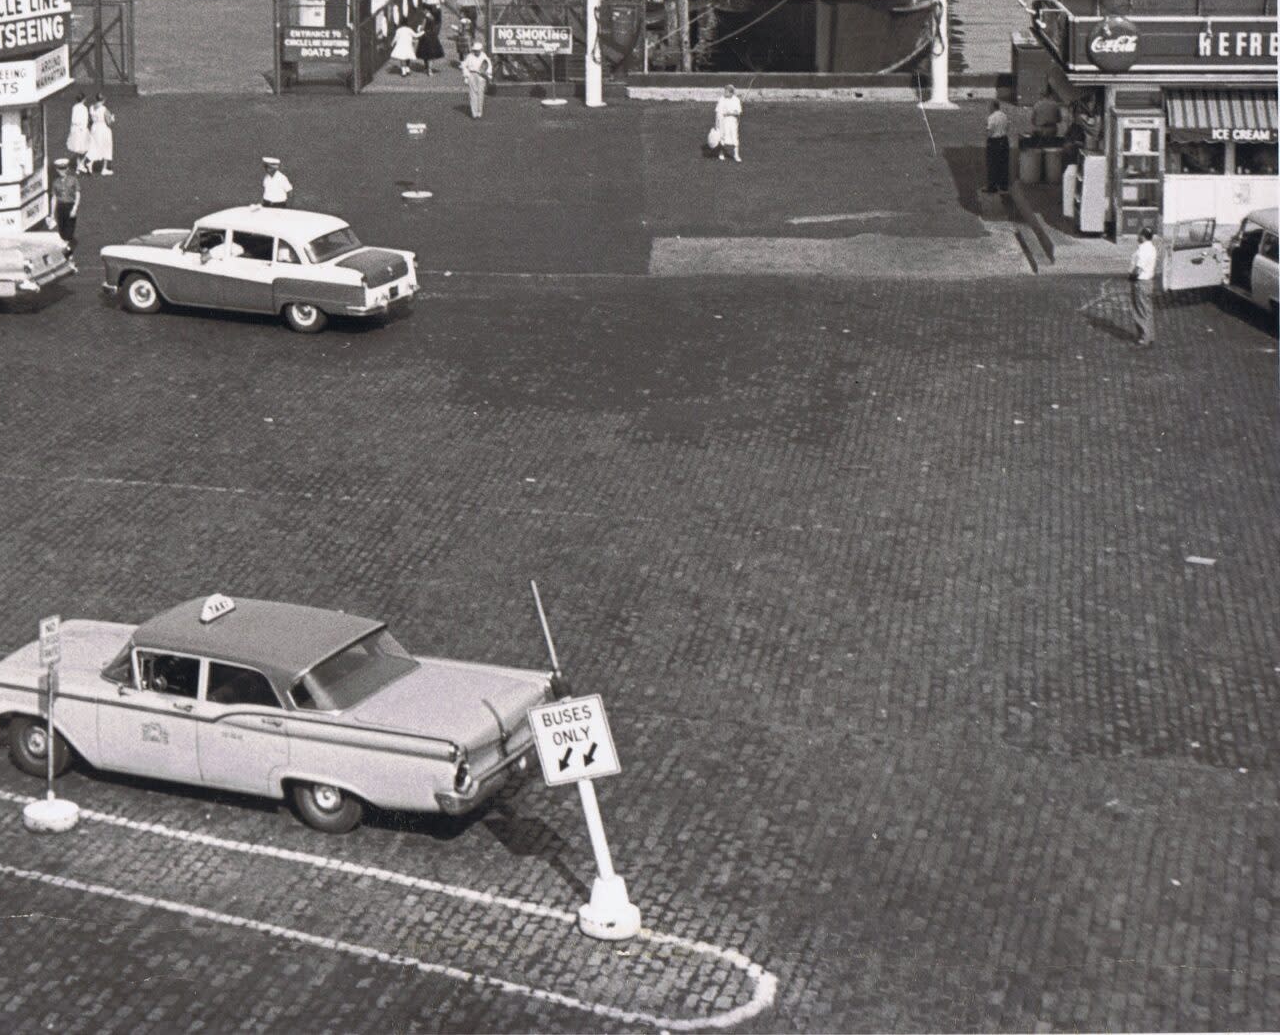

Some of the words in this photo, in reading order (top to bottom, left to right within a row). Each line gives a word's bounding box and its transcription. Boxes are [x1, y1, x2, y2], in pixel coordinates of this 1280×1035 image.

[290, 29, 330, 38] ENTRANCE
[498, 28, 514, 40] NO
[515, 28, 569, 40] SMOKING
[301, 47, 331, 57] BOATS
[1212, 128, 1230, 140] ICE
[1232, 128, 1270, 140] CREAM
[207, 599, 230, 615] TAXI
[541, 705, 592, 727] BUSES
[552, 725, 591, 746] ONLY
